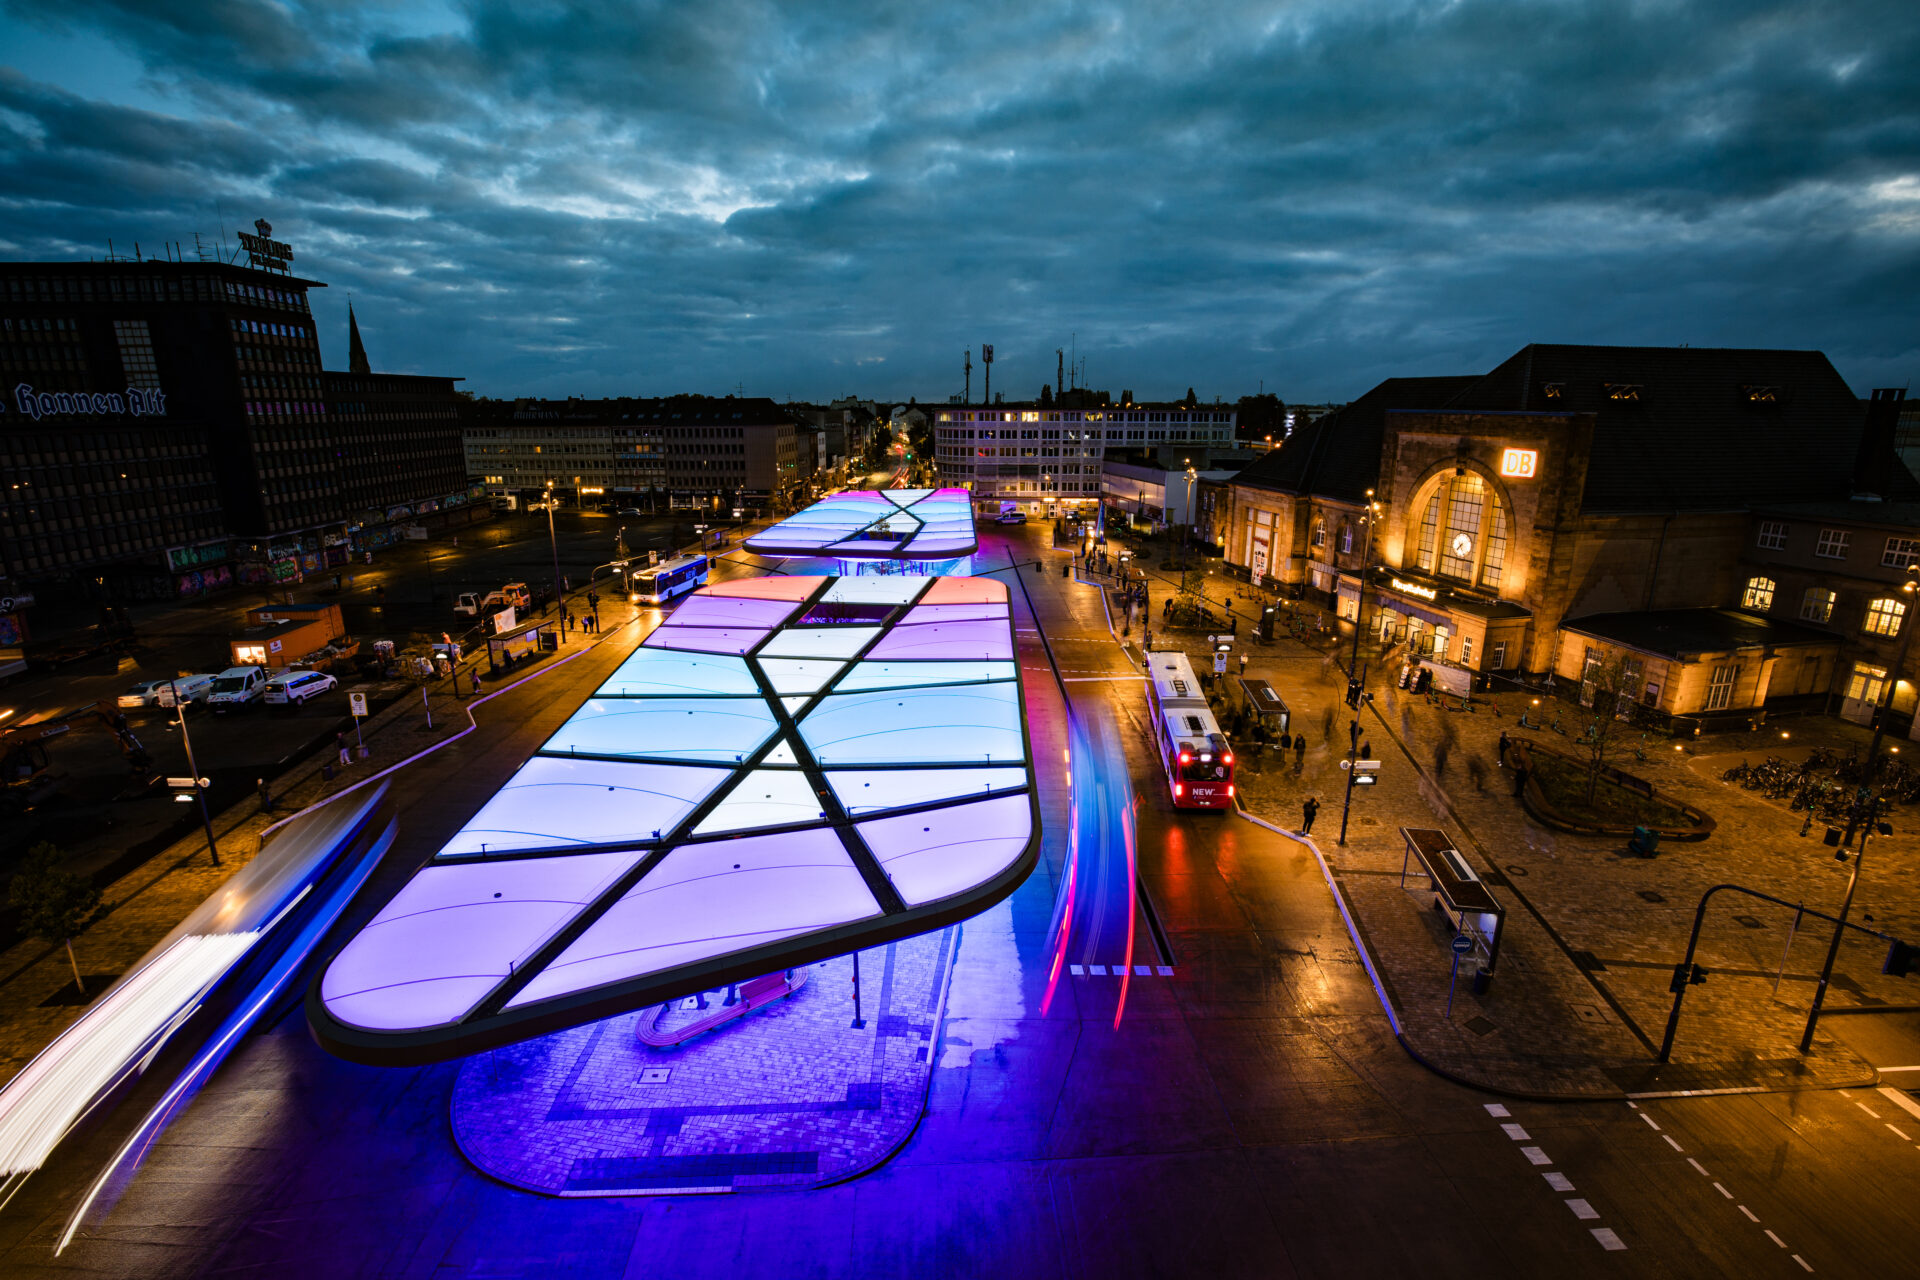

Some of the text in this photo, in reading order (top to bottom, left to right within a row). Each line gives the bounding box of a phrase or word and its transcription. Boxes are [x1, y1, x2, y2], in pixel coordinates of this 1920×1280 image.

[15, 383, 167, 421] Hannen Alt
[1506, 452, 1532, 474] DB
[1392, 578, 1436, 600] Hauptbahnhof
[1192, 788, 1214, 796] NEW
